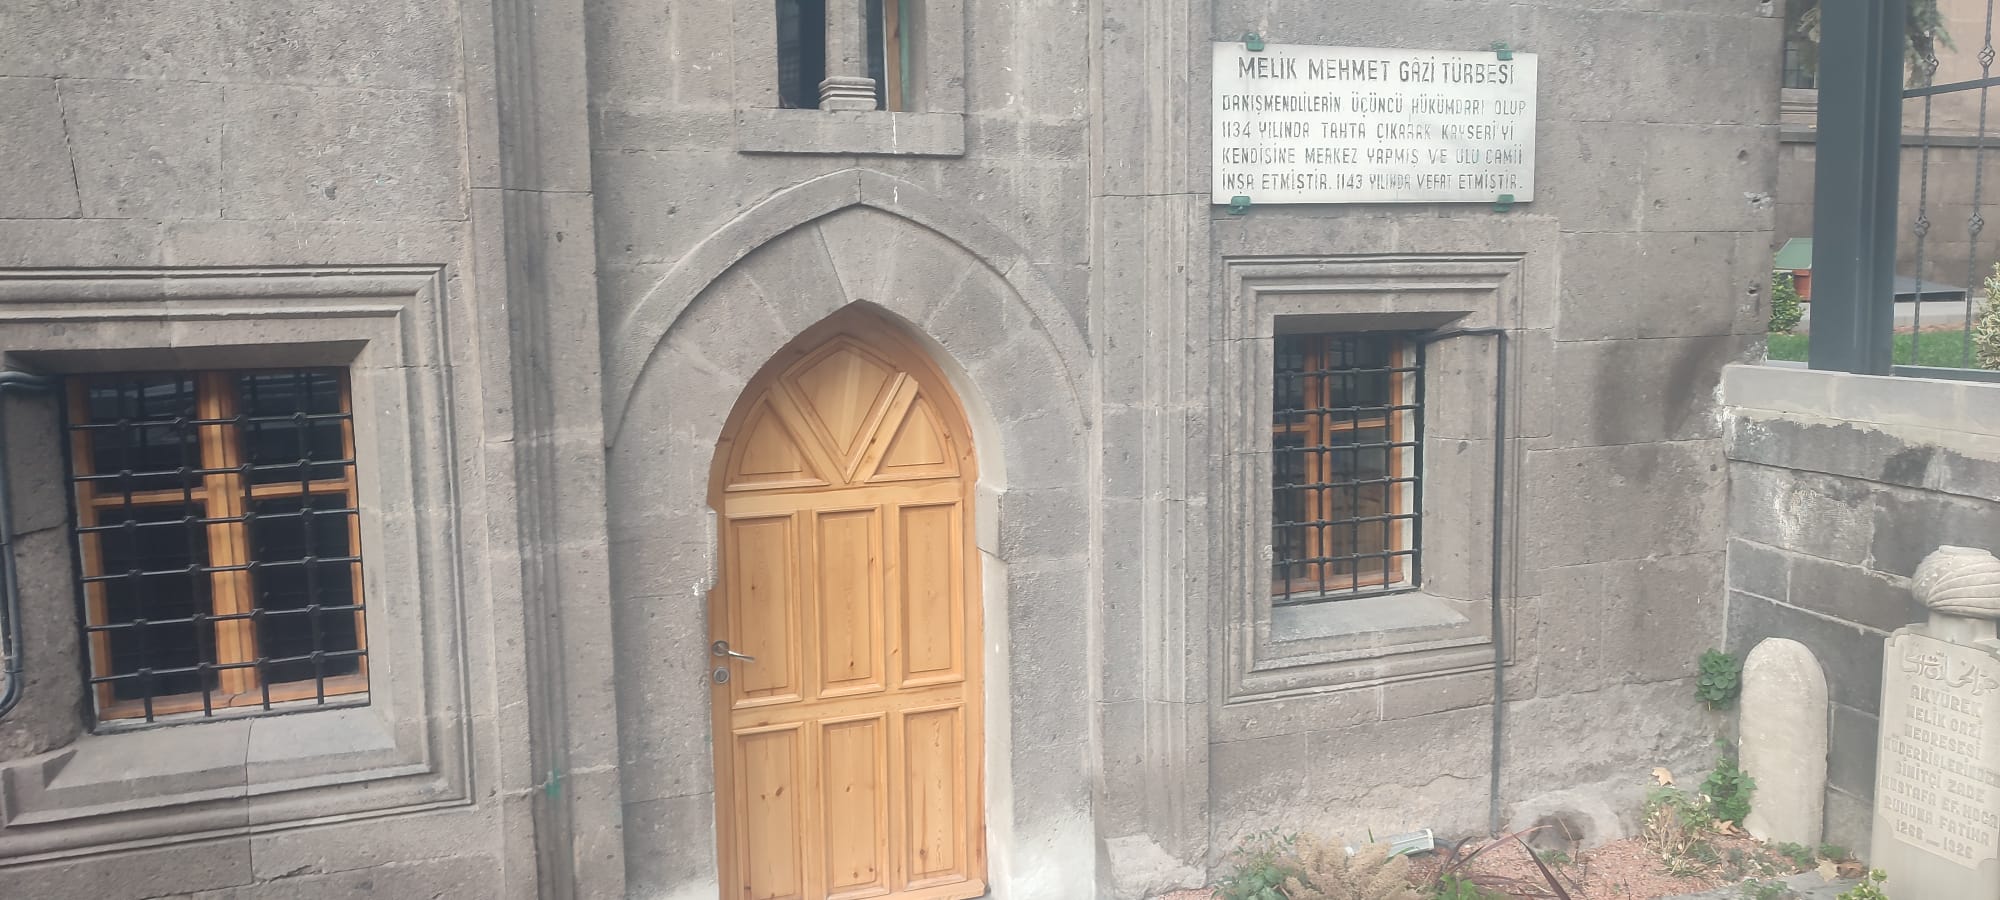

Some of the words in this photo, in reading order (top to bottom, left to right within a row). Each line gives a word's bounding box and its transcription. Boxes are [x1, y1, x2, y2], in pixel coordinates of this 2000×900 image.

[1238, 51, 1297, 79] MELİK
[1308, 58, 1390, 81] MEHMET
[1400, 56, 1435, 83] GÂZİ
[1352, 91, 1403, 118] ÜÇÜNCÜ
[1411, 93, 1484, 116] HÜKÜMDARI
[1495, 100, 1526, 116] OLUP
[1222, 121, 1251, 138] 1134
[1258, 121, 1310, 138] YILINDA
[1321, 122, 1366, 139] TAHTA
[1222, 143, 1295, 164] KENDİSİNE
[1305, 148, 1358, 164] MERKEZ
[1428, 148, 1448, 164] VE
[1456, 148, 1480, 164] ULU
[1222, 168, 1254, 194] İNŞA
[1336, 173, 1363, 190] 1143
[1369, 173, 1411, 190] YILINDA
[1417, 173, 1452, 190] VEFAT
